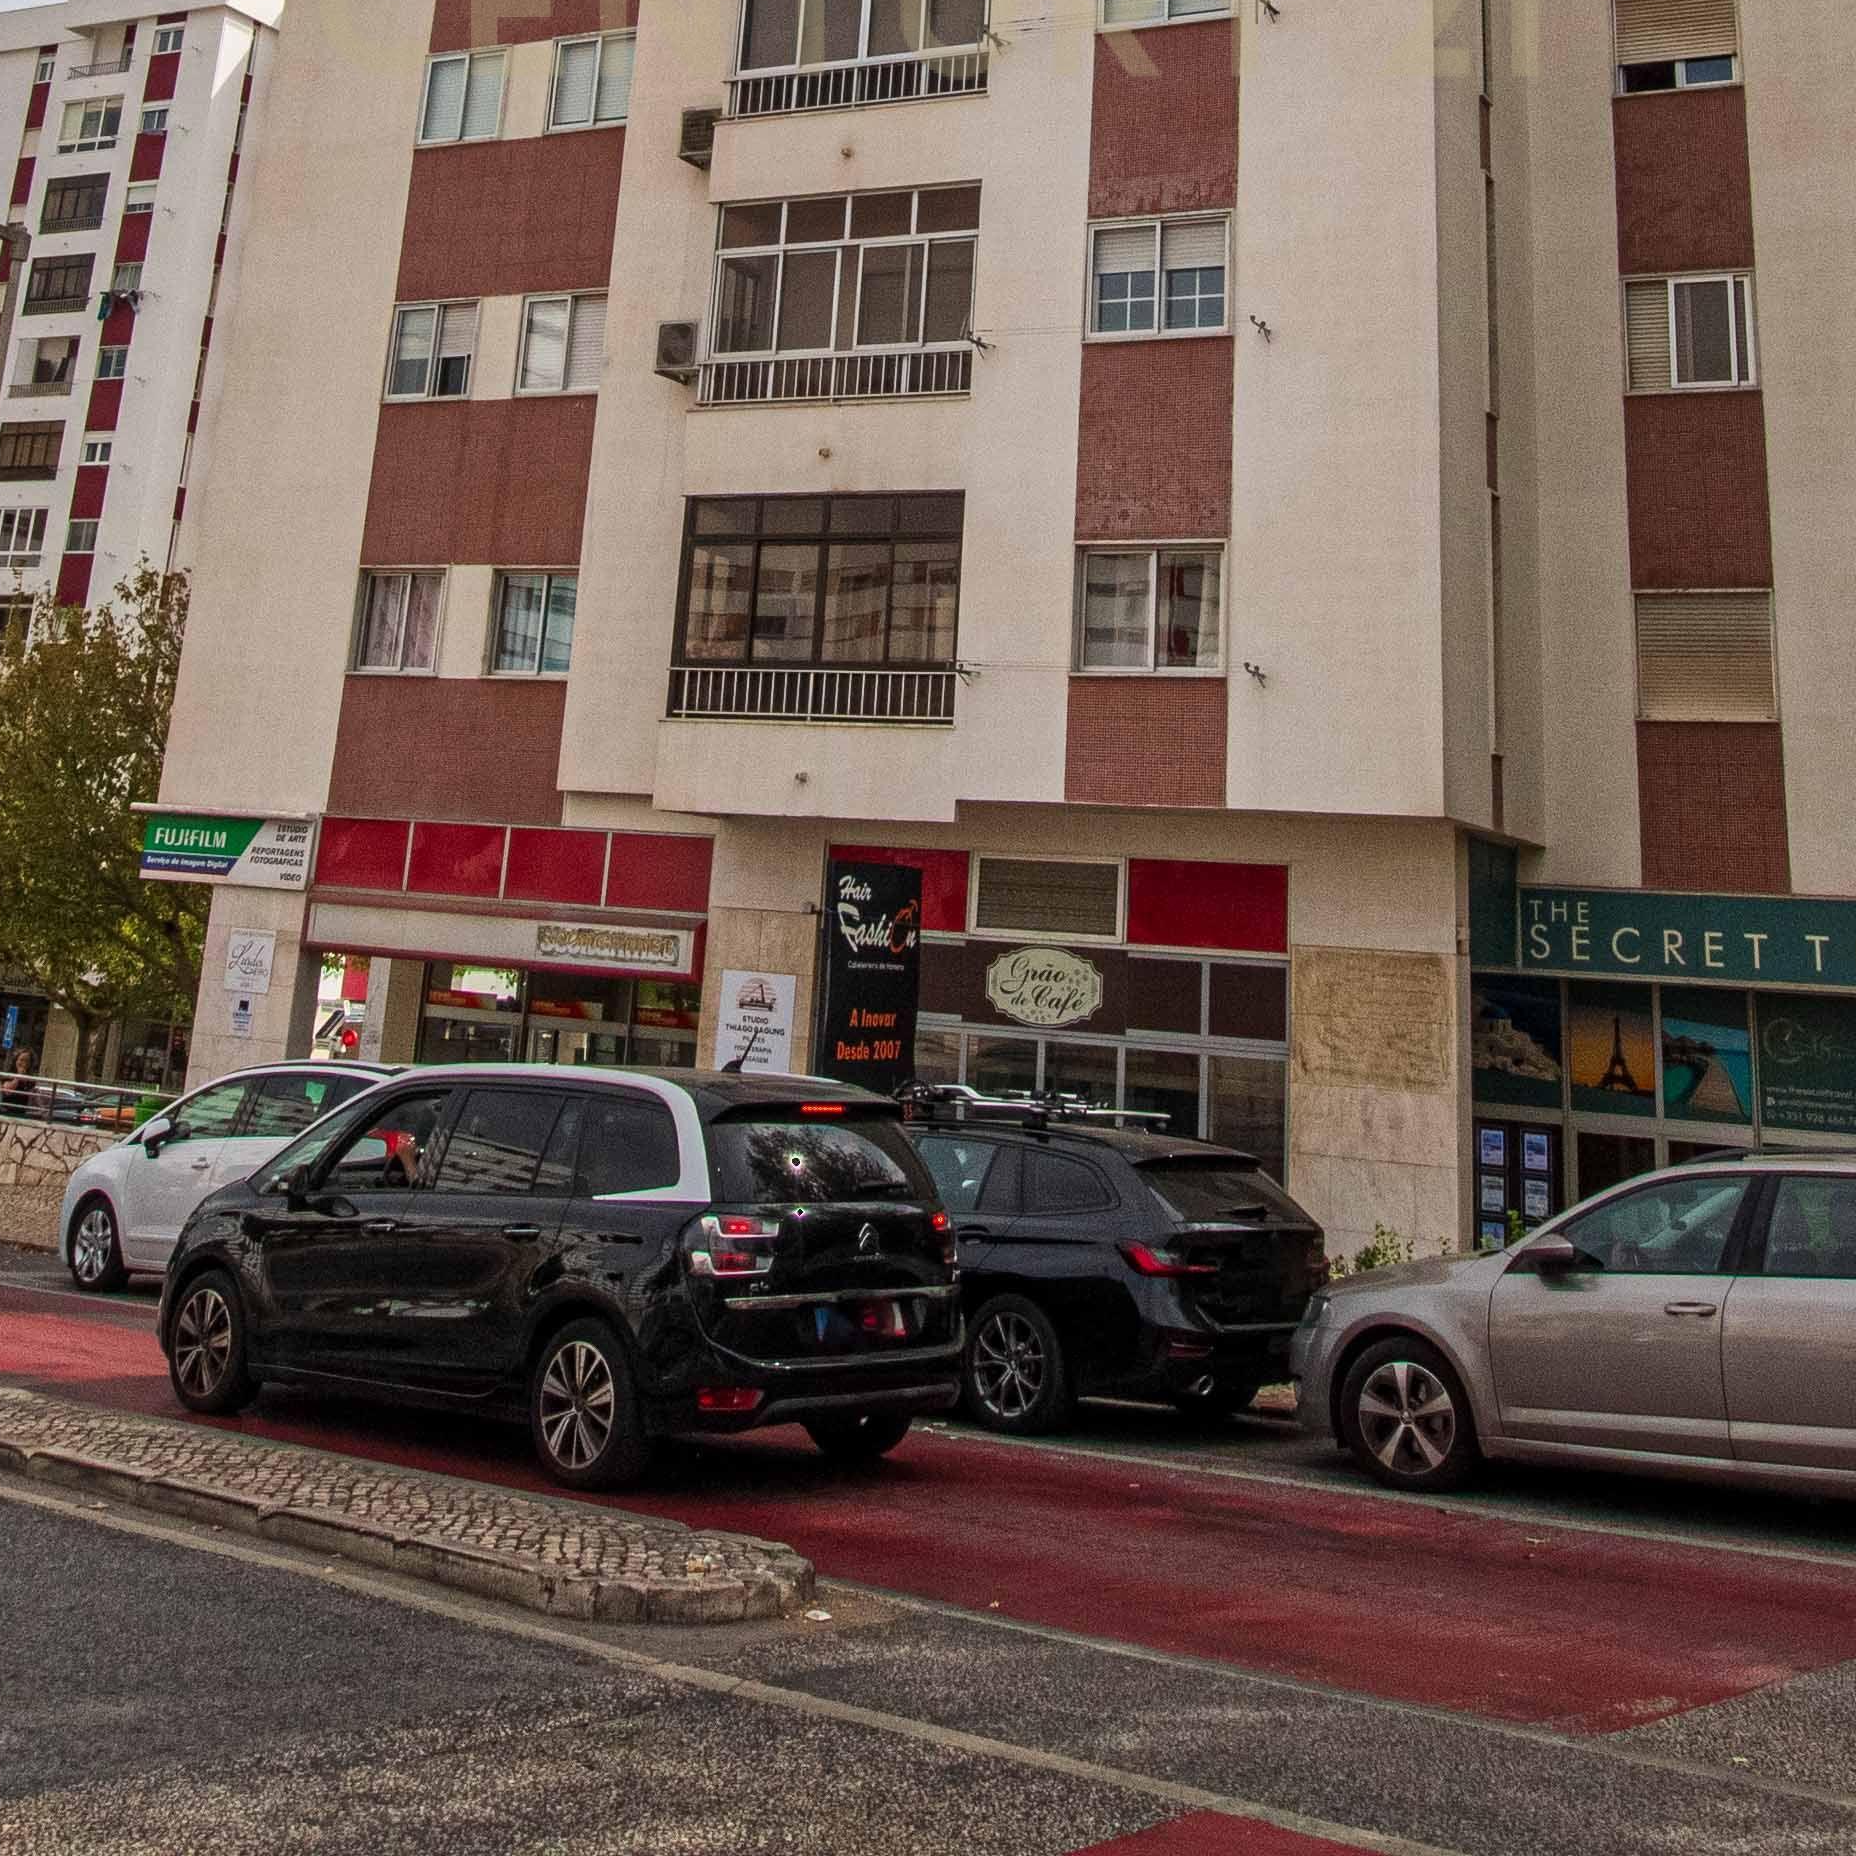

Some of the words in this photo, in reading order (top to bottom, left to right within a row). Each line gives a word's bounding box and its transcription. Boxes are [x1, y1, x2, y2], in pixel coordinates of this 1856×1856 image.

[154, 827, 227, 849] FUJIFILM
[251, 846, 305, 858] REPORTAGENS
[838, 875, 872, 901] Hair
[1528, 899, 1589, 924] THE
[1529, 923, 1769, 969] SECRET
[1000, 956, 1065, 994] Grão
[1010, 992, 1026, 1005] de
[1031, 984, 1086, 1019] Café
[742, 1015, 769, 1025] STUDIO
[849, 1008, 859, 1027] A
[861, 1008, 897, 1027] Inovar
[836, 1040, 871, 1061] Desde
[872, 1040, 902, 1061] 2007
